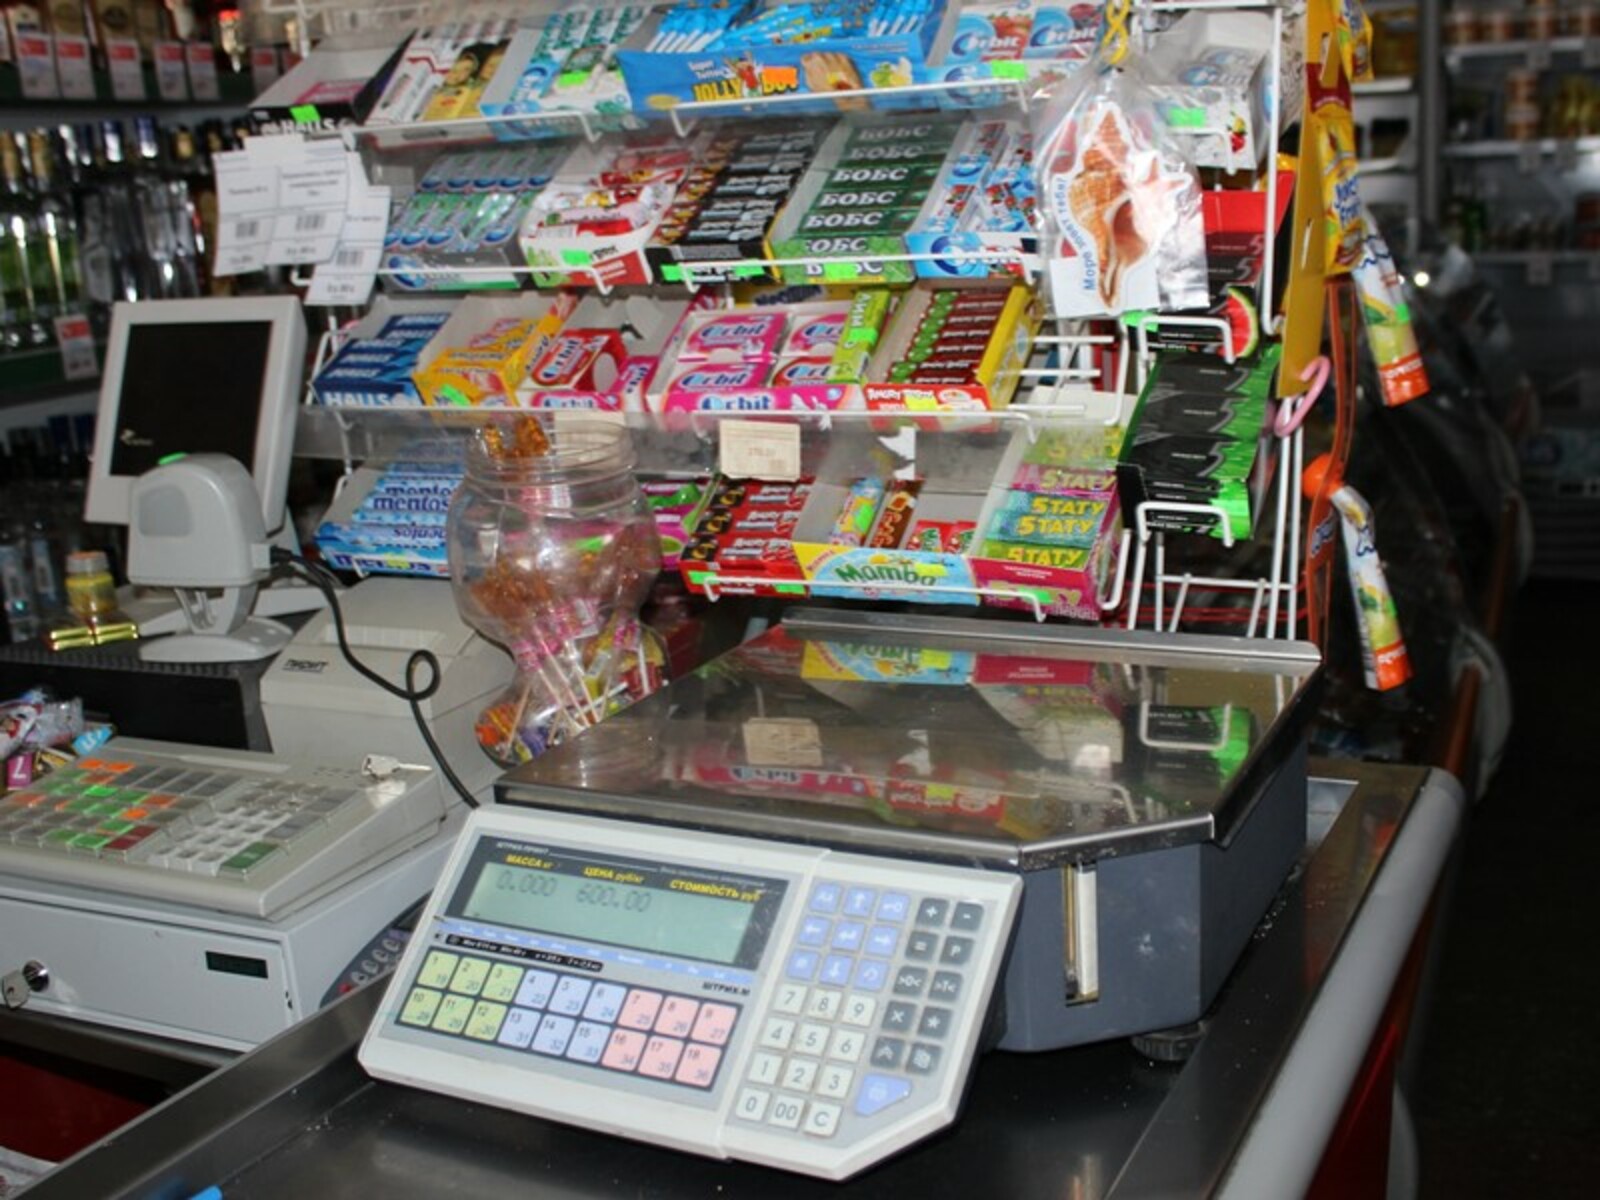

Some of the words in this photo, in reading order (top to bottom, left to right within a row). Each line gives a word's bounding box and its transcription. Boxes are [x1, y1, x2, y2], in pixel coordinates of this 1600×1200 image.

[952, 31, 1021, 56] Orbit
[693, 77, 742, 101] JOLLY
[831, 167, 909, 182] БОБС
[819, 190, 898, 207] БОБС
[803, 211, 884, 228] БОБС
[702, 322, 765, 338] Orbit
[681, 372, 748, 386] Orbit
[701, 394, 772, 411] Orbit
[505, 854, 542, 869] МАССА
[583, 866, 614, 880] ЦЕНА
[496, 869, 557, 897] 0.000
[669, 878, 739, 899] СТОИМОСТЬ
[783, 991, 796, 1005] 7
[818, 996, 829, 1011] 8
[854, 1002, 865, 1017] 9
[771, 1026, 782, 1041] 4
[806, 1031, 817, 1047] 5
[841, 1038, 851, 1053] 6
[762, 1062, 768, 1077] 1
[792, 1068, 804, 1084] 2
[828, 1074, 840, 1090] 3
[745, 1096, 757, 1112] 0
[774, 1103, 799, 1121] 00
[813, 1112, 830, 1128] C
